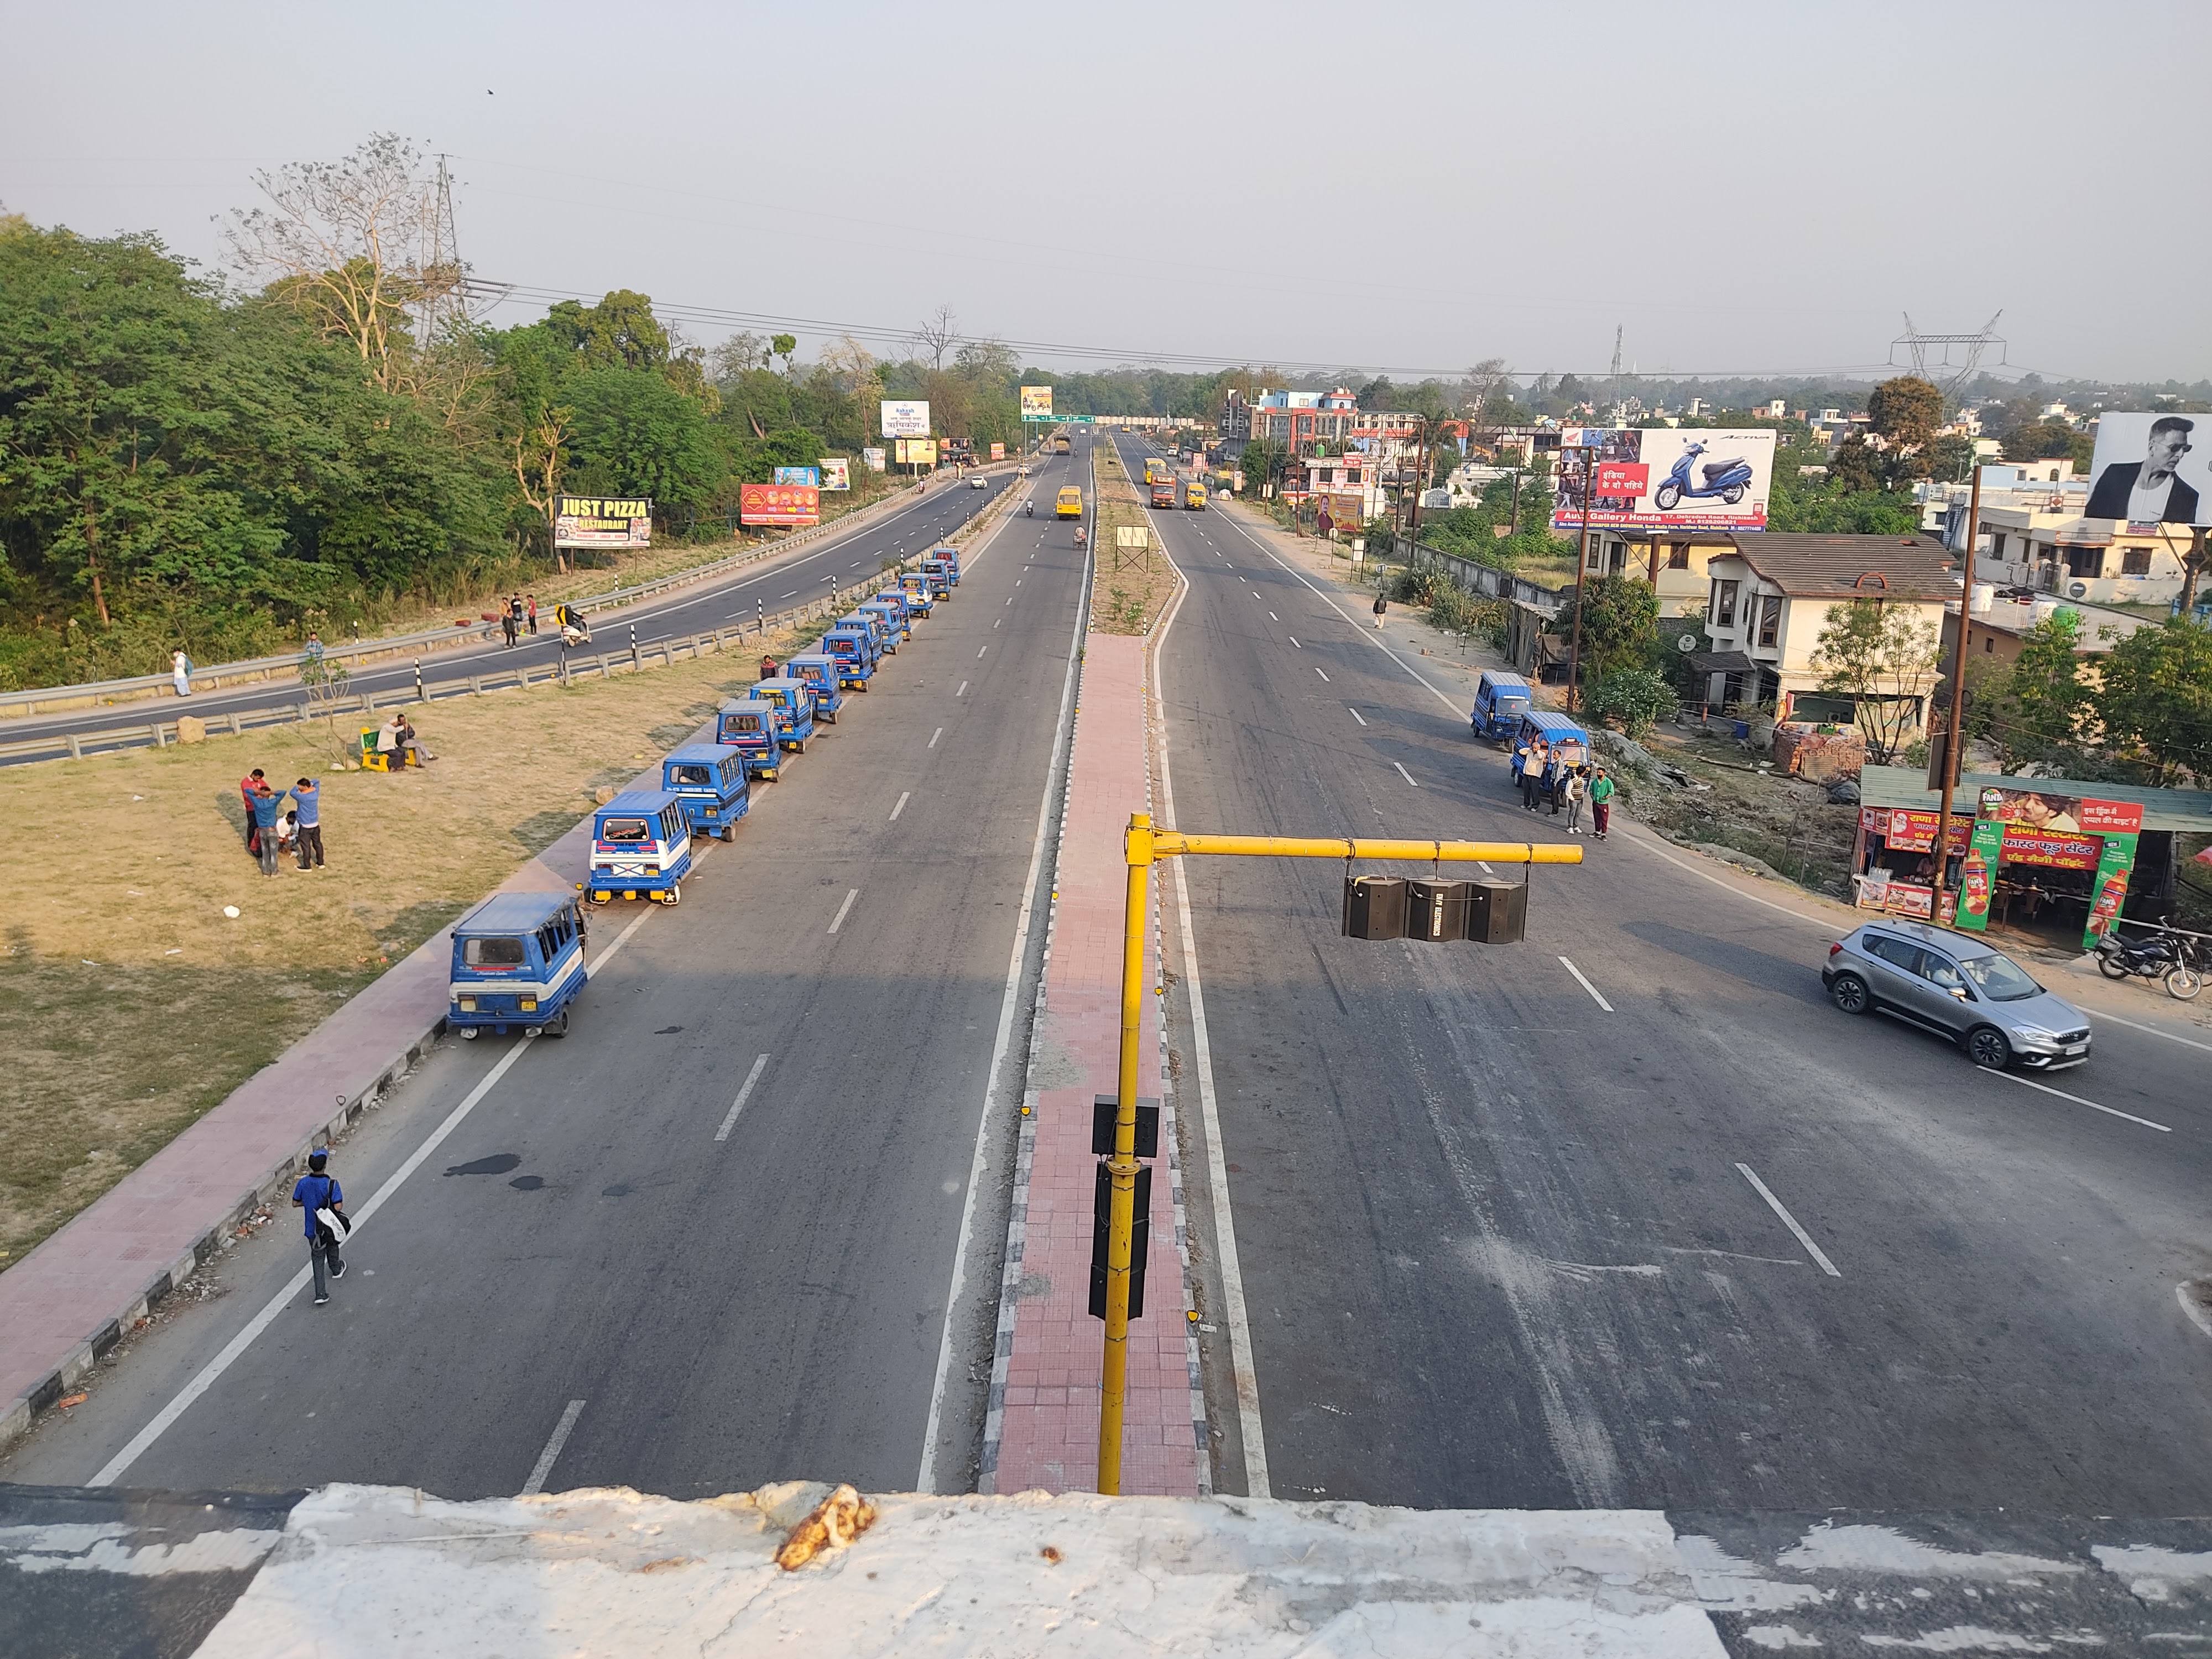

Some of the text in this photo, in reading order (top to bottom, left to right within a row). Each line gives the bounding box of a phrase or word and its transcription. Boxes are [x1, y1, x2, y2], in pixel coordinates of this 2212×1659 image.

[1603, 469, 1625, 480] इंडिया
[1602, 480, 1644, 489] के दो पहिये
[561, 498, 646, 517] JUST PIZZA
[1590, 513, 1626, 523] Gallery
[579, 519, 628, 529] RESTAURANT
[1983, 792, 2003, 801] FANTA
[1910, 815, 1932, 823] राणा
[2103, 816, 2112, 824] की
[2002, 838, 2037, 849] फास्ट
[2039, 841, 2063, 855] फूड
[2064, 842, 2094, 855] सेंटर
[1433, 907, 1442, 936] ELECTRONICS
